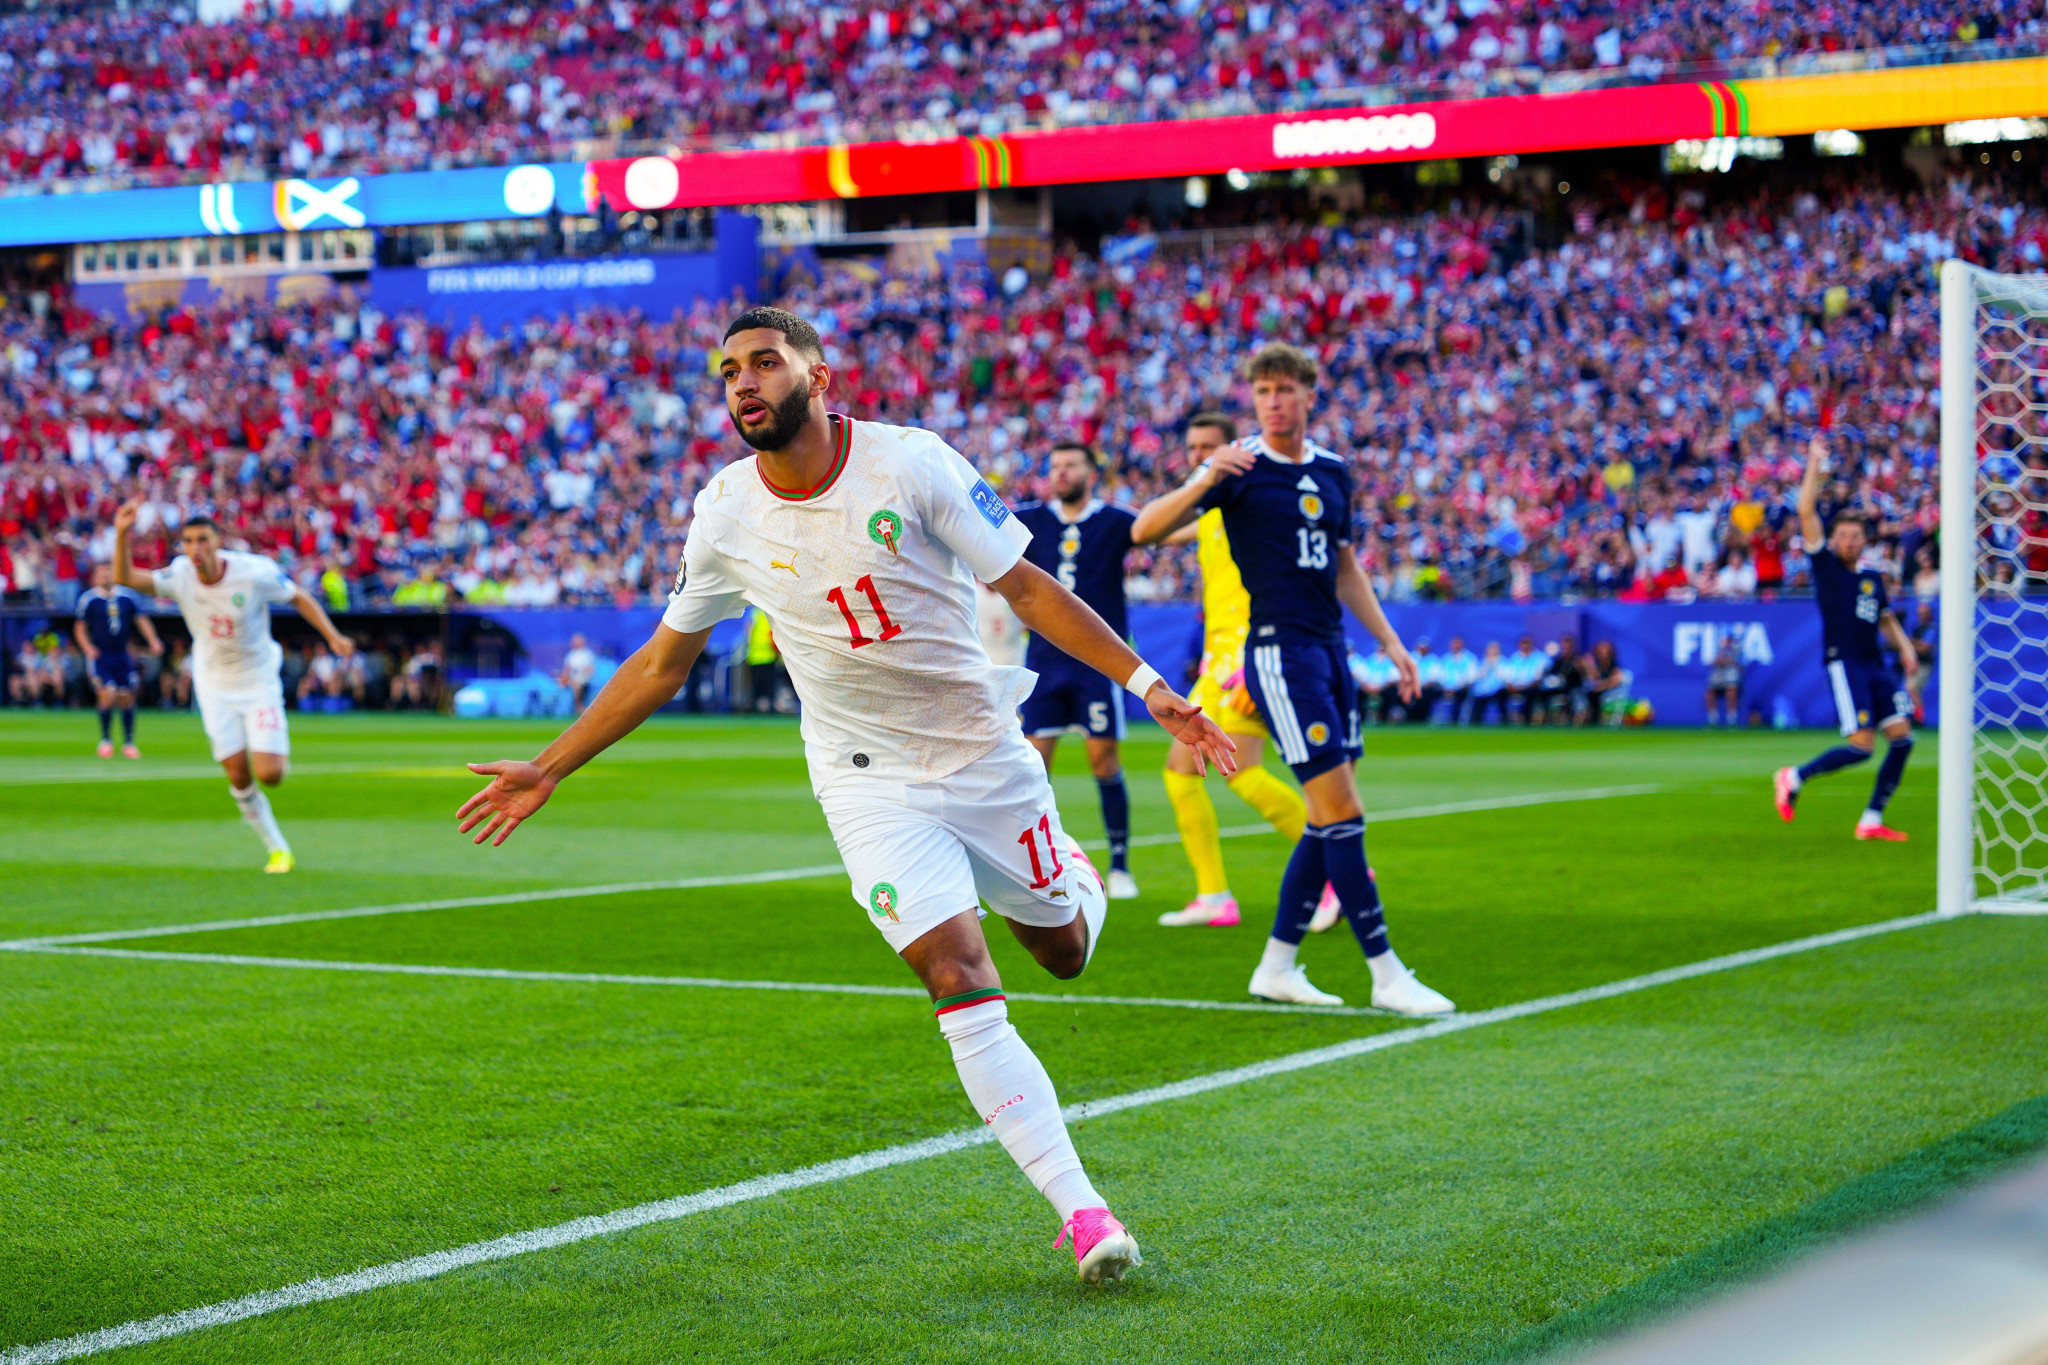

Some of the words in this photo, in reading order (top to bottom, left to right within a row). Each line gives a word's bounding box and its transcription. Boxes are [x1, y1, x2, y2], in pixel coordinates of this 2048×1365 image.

[1296, 528, 1328, 569] 13
[1057, 562, 1078, 592] 5
[826, 573, 902, 649] 11
[1087, 702, 1109, 732] 5
[1341, 709, 1364, 748] 1
[1017, 813, 1063, 889] 11
